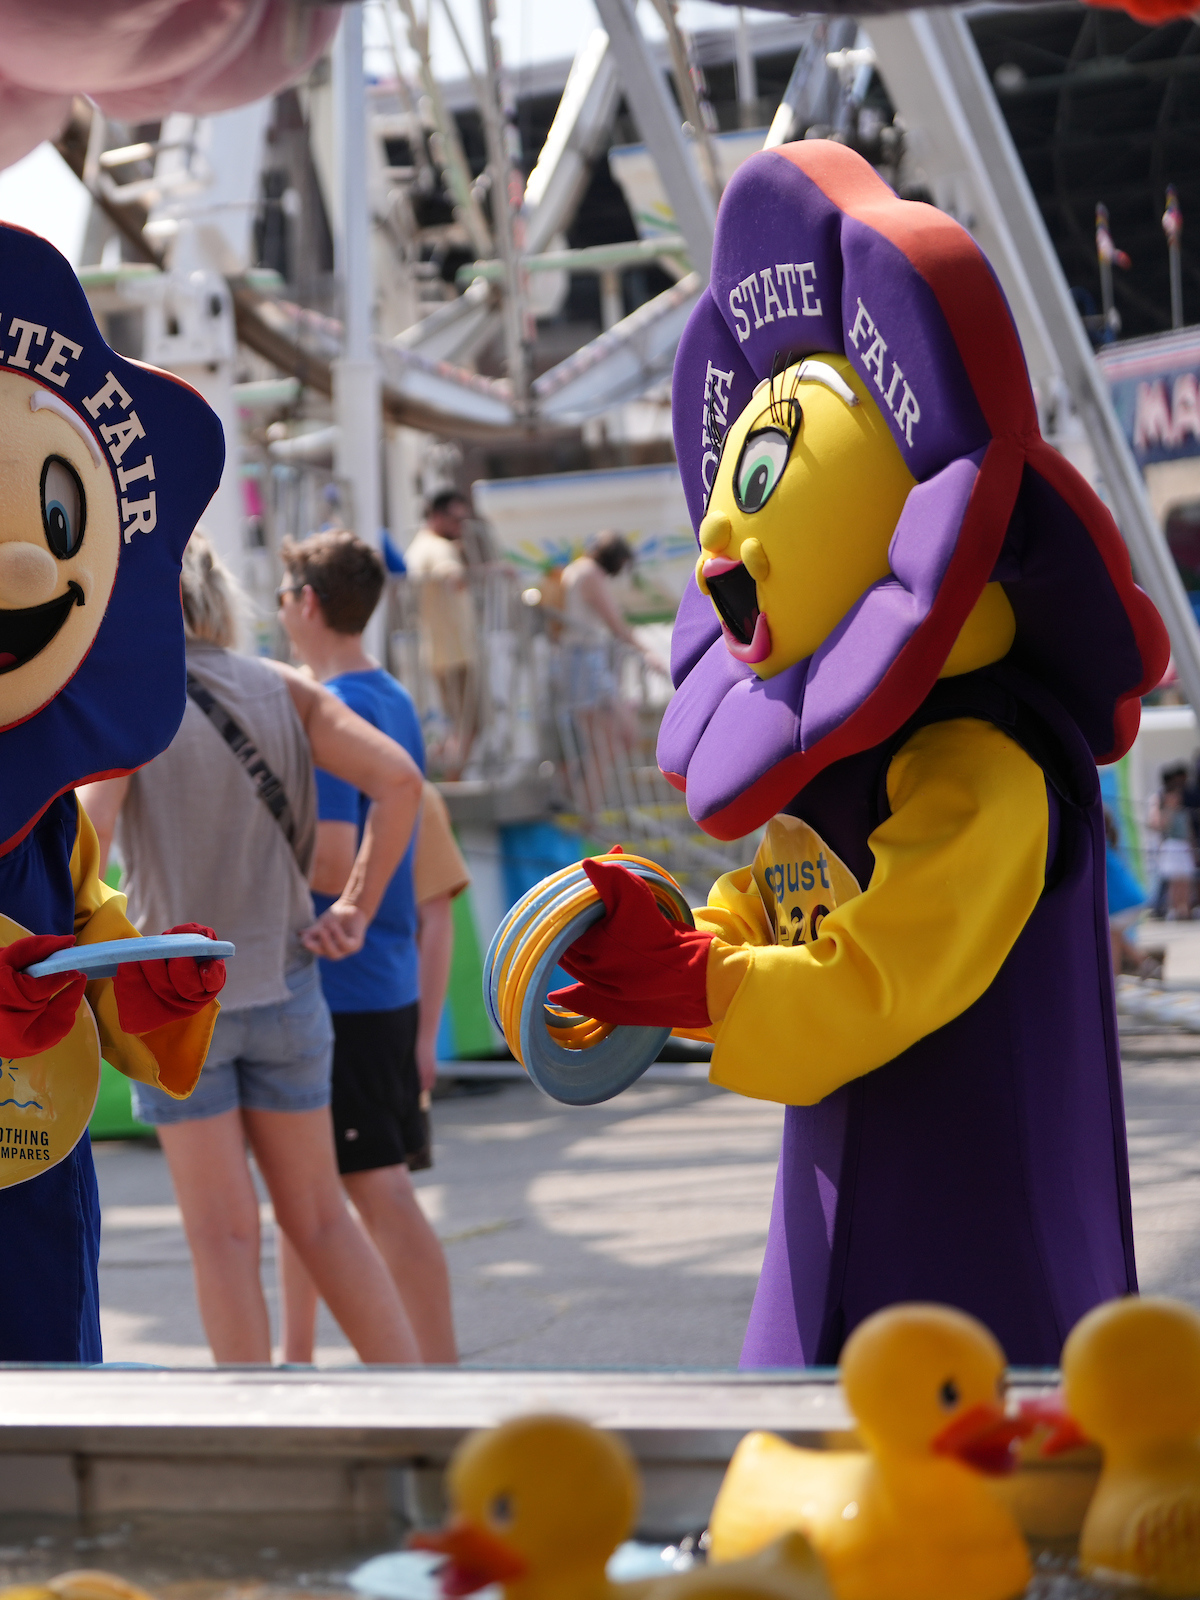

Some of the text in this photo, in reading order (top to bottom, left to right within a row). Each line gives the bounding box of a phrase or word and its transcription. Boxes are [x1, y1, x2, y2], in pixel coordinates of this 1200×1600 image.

[82, 371, 159, 545] FAIR
[702, 261, 921, 515] OWA STATE FAIR
